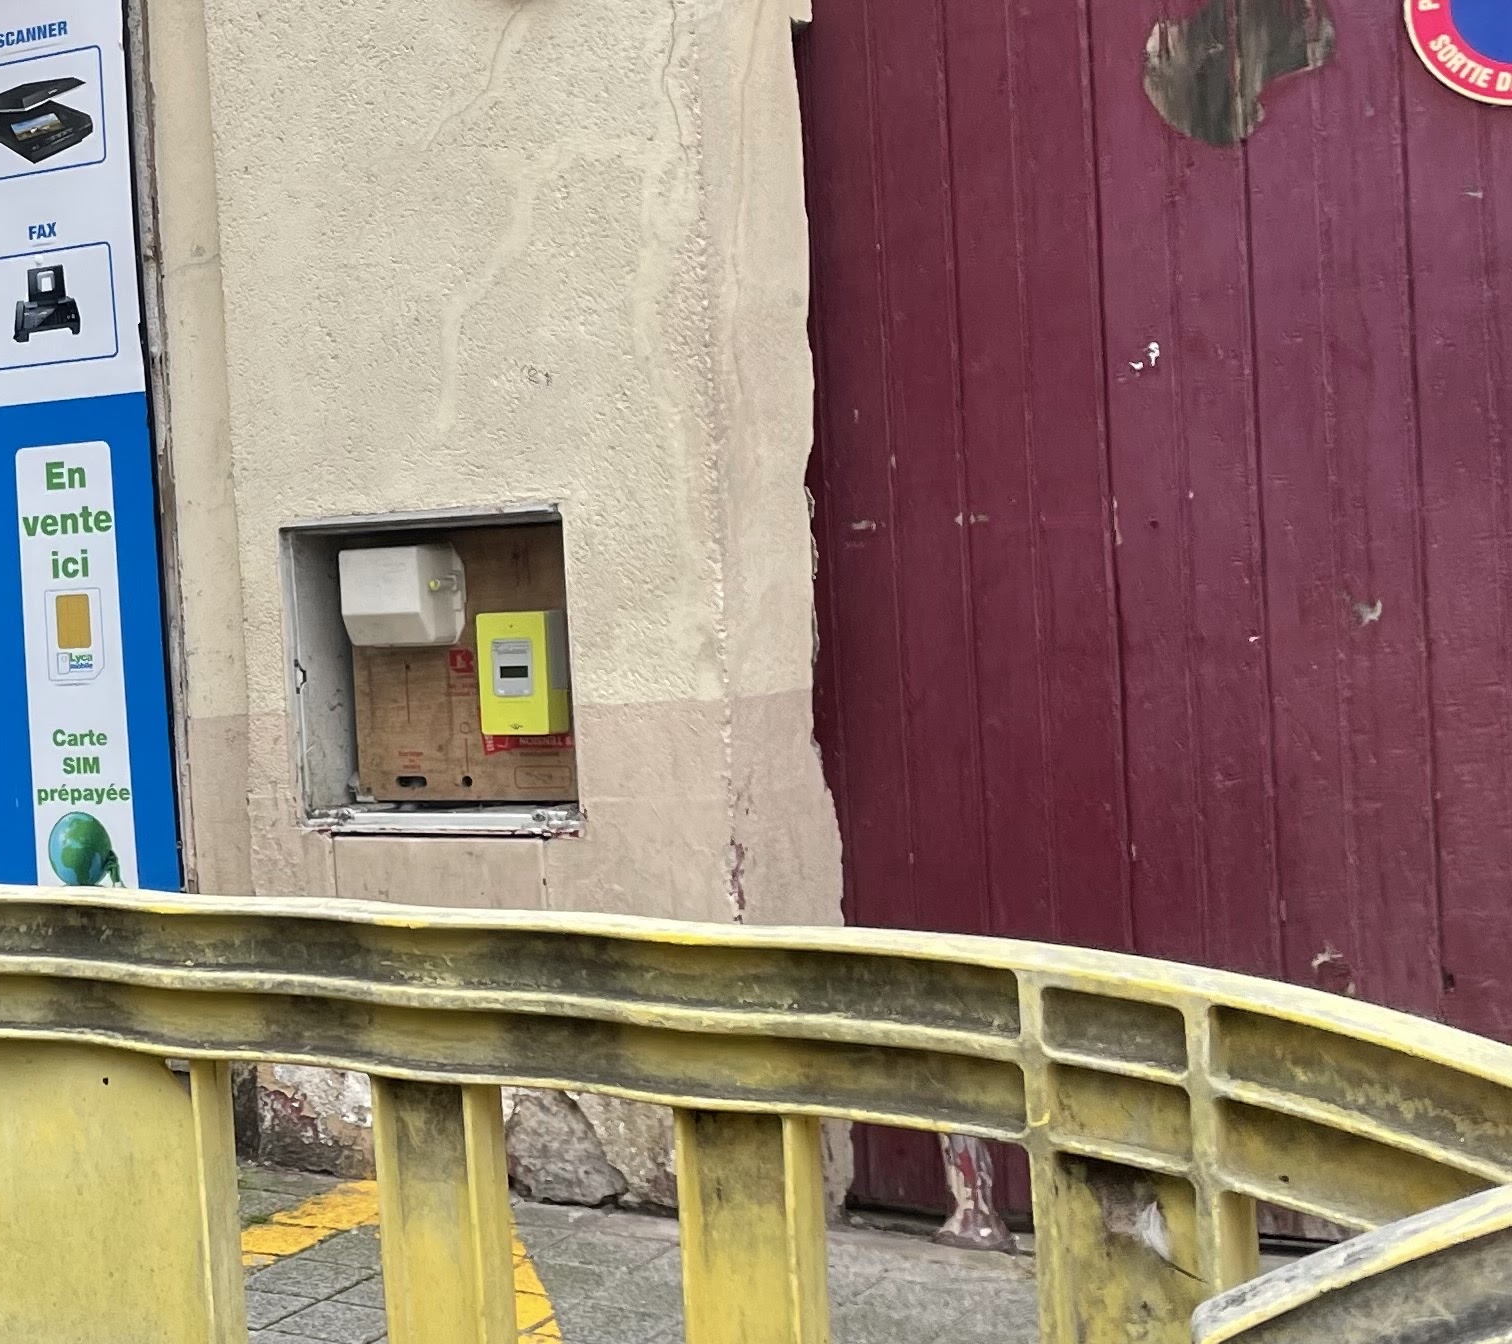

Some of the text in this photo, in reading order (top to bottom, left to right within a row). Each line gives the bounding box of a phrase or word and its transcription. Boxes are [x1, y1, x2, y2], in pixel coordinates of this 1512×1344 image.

[1429, 34, 1512, 92] SORTIE D
[28, 222, 57, 241] FAX
[44, 461, 86, 491] En
[21, 504, 113, 538] vente
[51, 550, 89, 580] ici
[53, 728, 108, 748] Carte
[62, 756, 100, 775] SIM
[37, 782, 130, 809] prépayée
